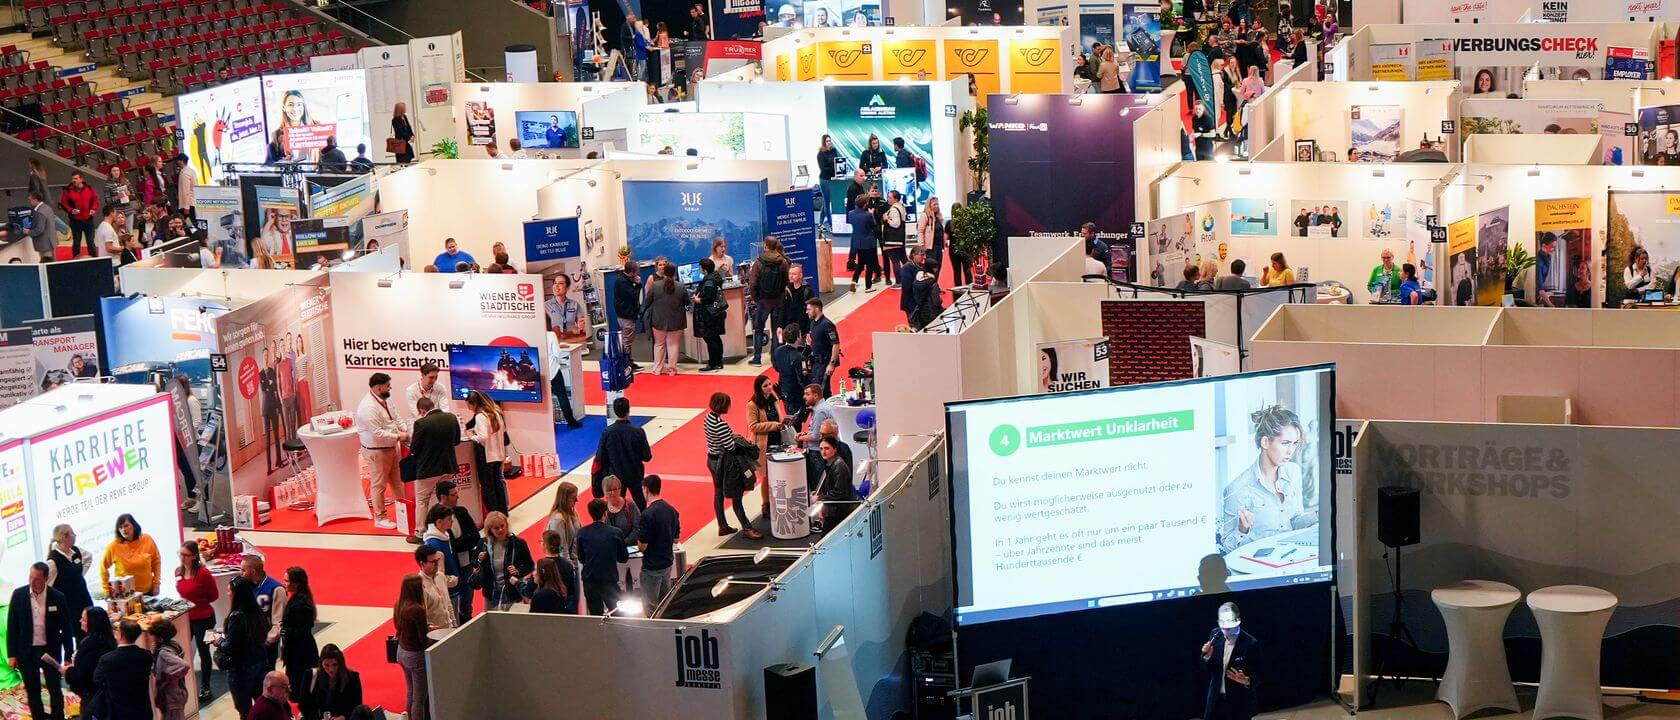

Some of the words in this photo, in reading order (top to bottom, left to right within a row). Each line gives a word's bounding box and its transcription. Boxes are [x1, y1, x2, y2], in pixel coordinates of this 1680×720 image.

[1543, 2, 1568, 10] KEIN
[1426, 37, 1598, 52] ERBUNGSCHECK
[1130, 225, 1143, 235] 42
[1200, 231, 1216, 242] Atoll
[1432, 230, 1445, 239] 40
[480, 292, 517, 301] WIENER
[50, 326, 61, 334] als
[53, 342, 95, 353] MANAGER
[343, 338, 369, 350] Hier
[372, 339, 437, 353] bewerben
[1096, 345, 1108, 356] 53
[212, 358, 226, 368] 54
[345, 354, 397, 368] Karriere
[399, 356, 449, 369] starten.
[1061, 371, 1086, 383] WIR
[1048, 380, 1101, 391] SUCHEN
[1029, 426, 1103, 444] Marktwert
[1106, 416, 1179, 435] Unklarheit
[49, 418, 147, 473] KARRIERE
[1000, 434, 1010, 447] 4
[1373, 440, 1544, 473] VORTRÄGE
[1545, 448, 1570, 472] &
[53, 446, 150, 501] FOREWER
[993, 477, 1007, 486] Du
[1009, 474, 1040, 485] kennst
[1041, 471, 1073, 482] deinen
[1075, 465, 1121, 478] Marktwert
[1375, 470, 1571, 500] WORKSHOPS
[56, 502, 79, 520] WERDE
[80, 499, 94, 512] TEIL
[94, 493, 108, 506] DER
[109, 486, 127, 499] REWE
[128, 477, 152, 494] GROUP!
[993, 501, 1007, 511] Du
[1010, 497, 1032, 509] wirst
[1034, 491, 1105, 507] möglicherweise
[1106, 485, 1156, 499] ausgenutzt
[1159, 481, 1180, 492] oder
[1182, 481, 1193, 490] zu
[994, 513, 1022, 523] wenig
[995, 539, 1004, 547] In
[1014, 535, 1033, 545] Jahr
[1035, 532, 1057, 545] geht
[1071, 529, 1085, 539] oft
[1086, 527, 1103, 537] nur
[1105, 526, 1120, 535] um
[1122, 523, 1136, 533] ein
[1138, 521, 1158, 533] paar
[1160, 516, 1198, 528] Tausend
[1003, 549, 1024, 559] über
[1026, 543, 1075, 557] Jahrzehnte
[1078, 538, 1098, 551] sind
[1099, 537, 1115, 547] das
[1117, 535, 1142, 545] meist
[996, 555, 1075, 571] Hunderttausende
[675, 629, 720, 687] job
[687, 669, 721, 683] messe
